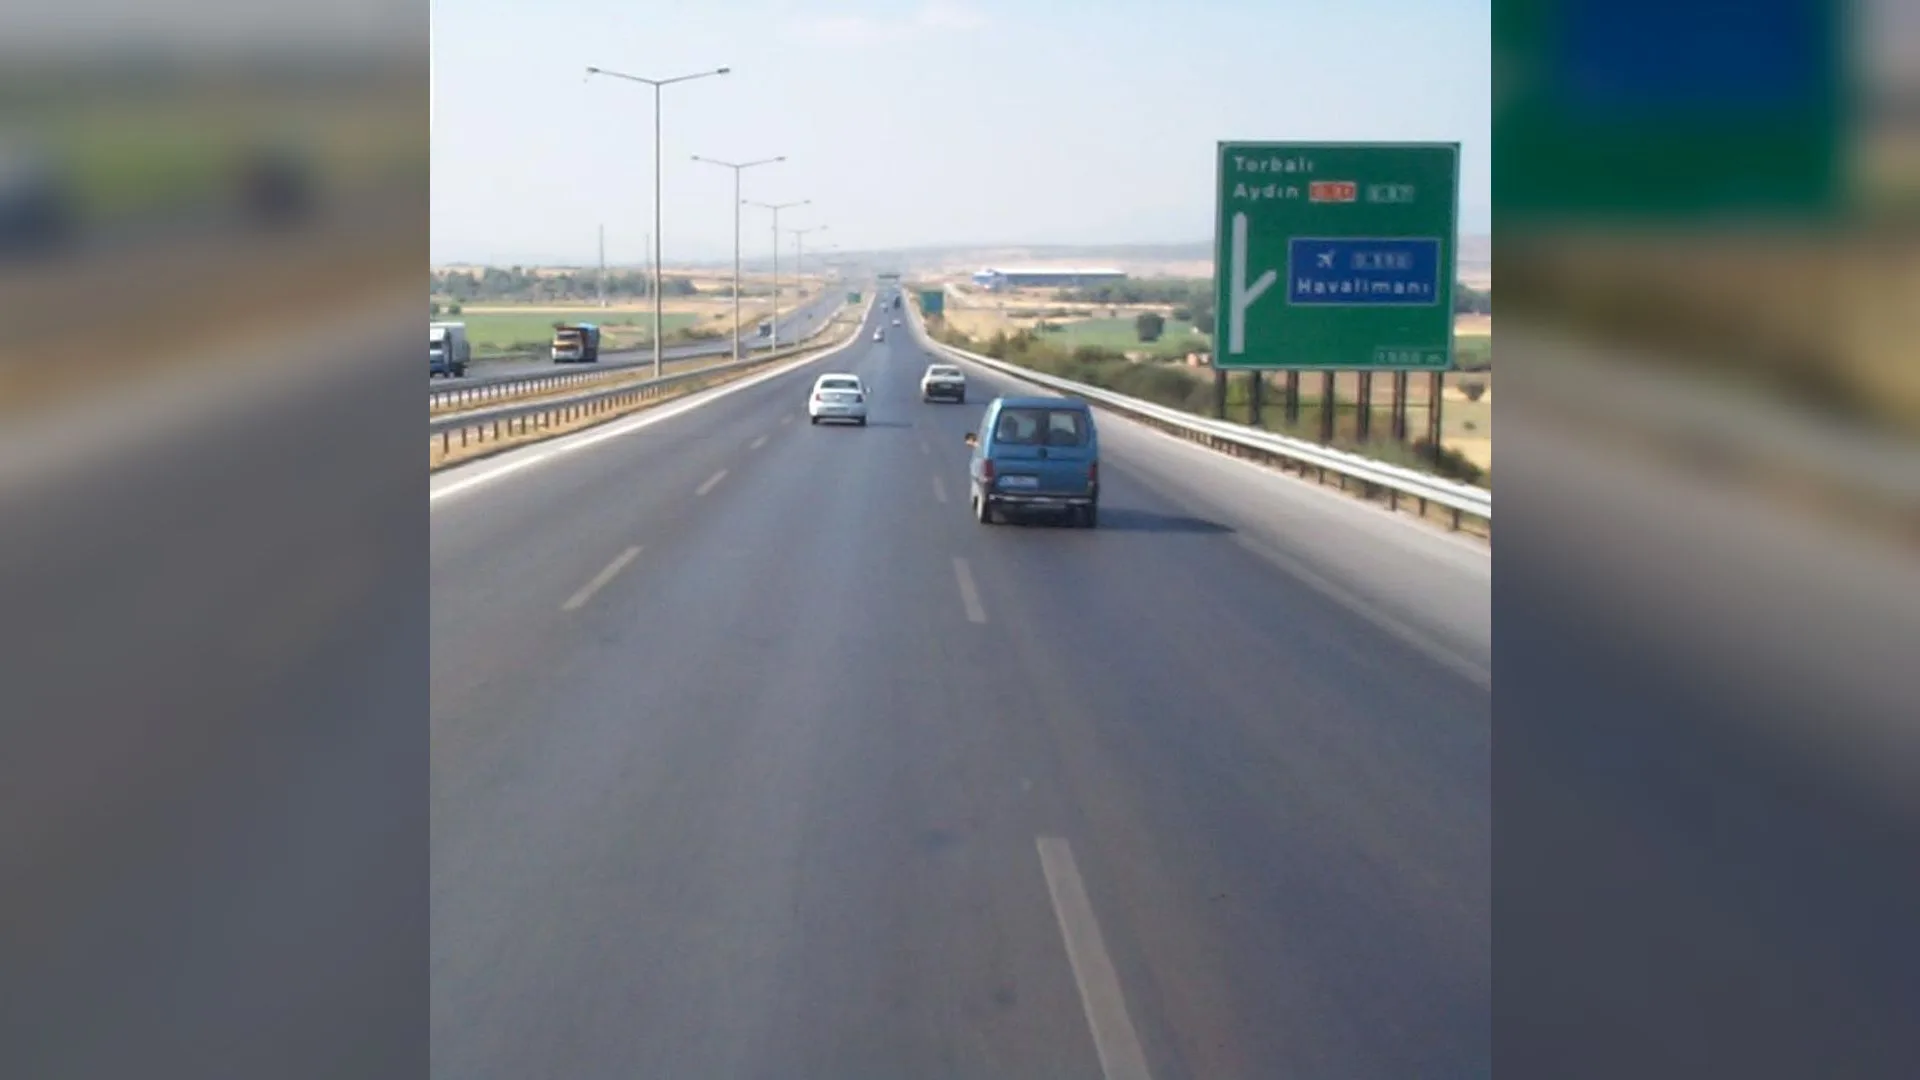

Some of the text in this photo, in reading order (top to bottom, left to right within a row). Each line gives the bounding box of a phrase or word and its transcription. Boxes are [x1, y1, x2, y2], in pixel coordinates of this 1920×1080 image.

[1233, 156, 1313, 172] Torbalı
[1233, 182, 1299, 200] Aydın
[1297, 277, 1430, 295] Havalimanı
